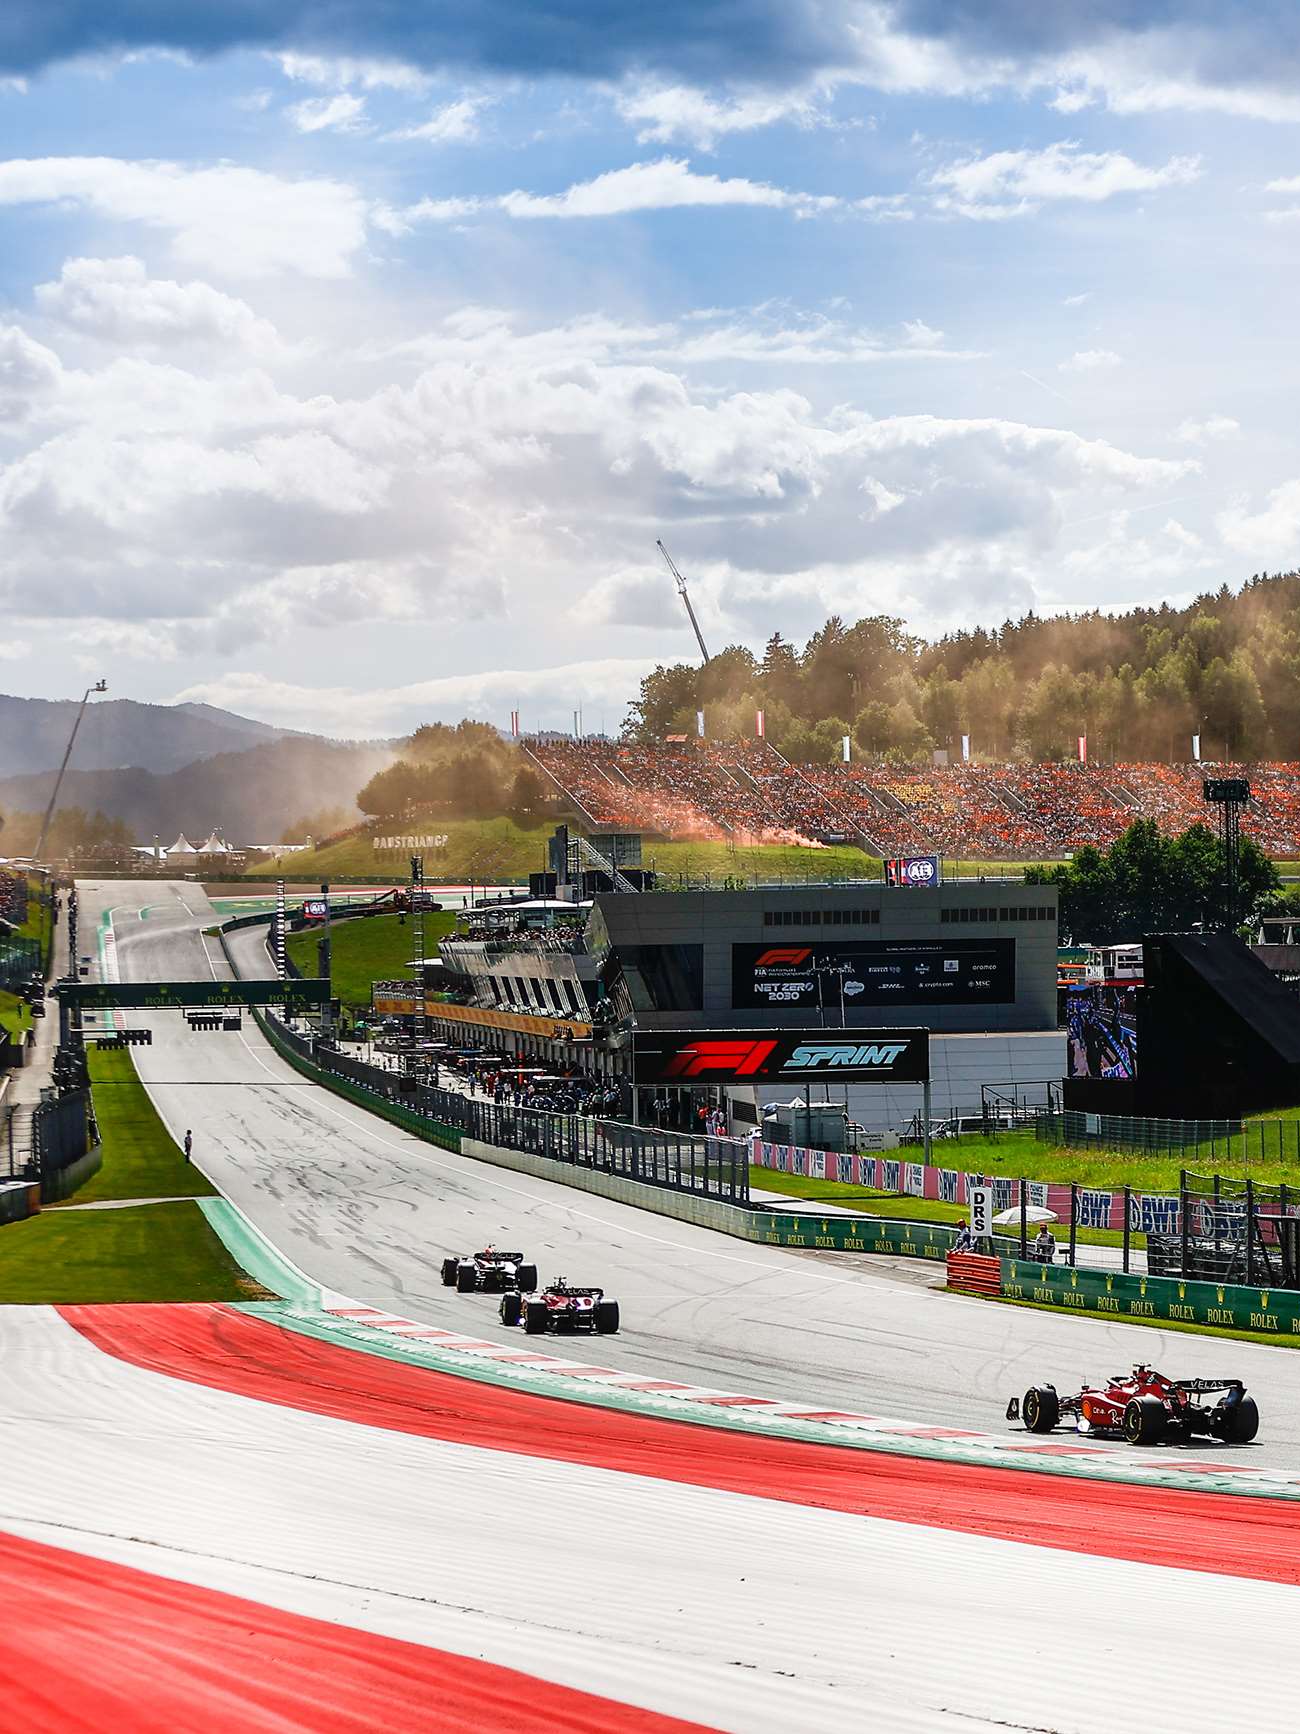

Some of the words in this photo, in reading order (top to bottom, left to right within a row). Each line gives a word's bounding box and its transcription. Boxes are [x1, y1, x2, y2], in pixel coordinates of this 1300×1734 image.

[754, 984, 781, 993] NET
[769, 992, 800, 1001] 2030
[661, 1040, 779, 1076] F1
[784, 1045, 908, 1067] SPRINT
[974, 1192, 985, 1231] DRS
[1081, 1190, 1112, 1228] BWT
[1141, 1197, 1180, 1234] BWT
[844, 1238, 864, 1250] ROLEX
[1063, 1292, 1085, 1307] ROLEX
[1098, 1296, 1120, 1312] ROLEX
[1131, 1300, 1154, 1316] ROLEX
[1169, 1304, 1195, 1320] ROLEX
[1207, 1308, 1234, 1325] ROLEX
[1250, 1313, 1279, 1330] ROLEX
